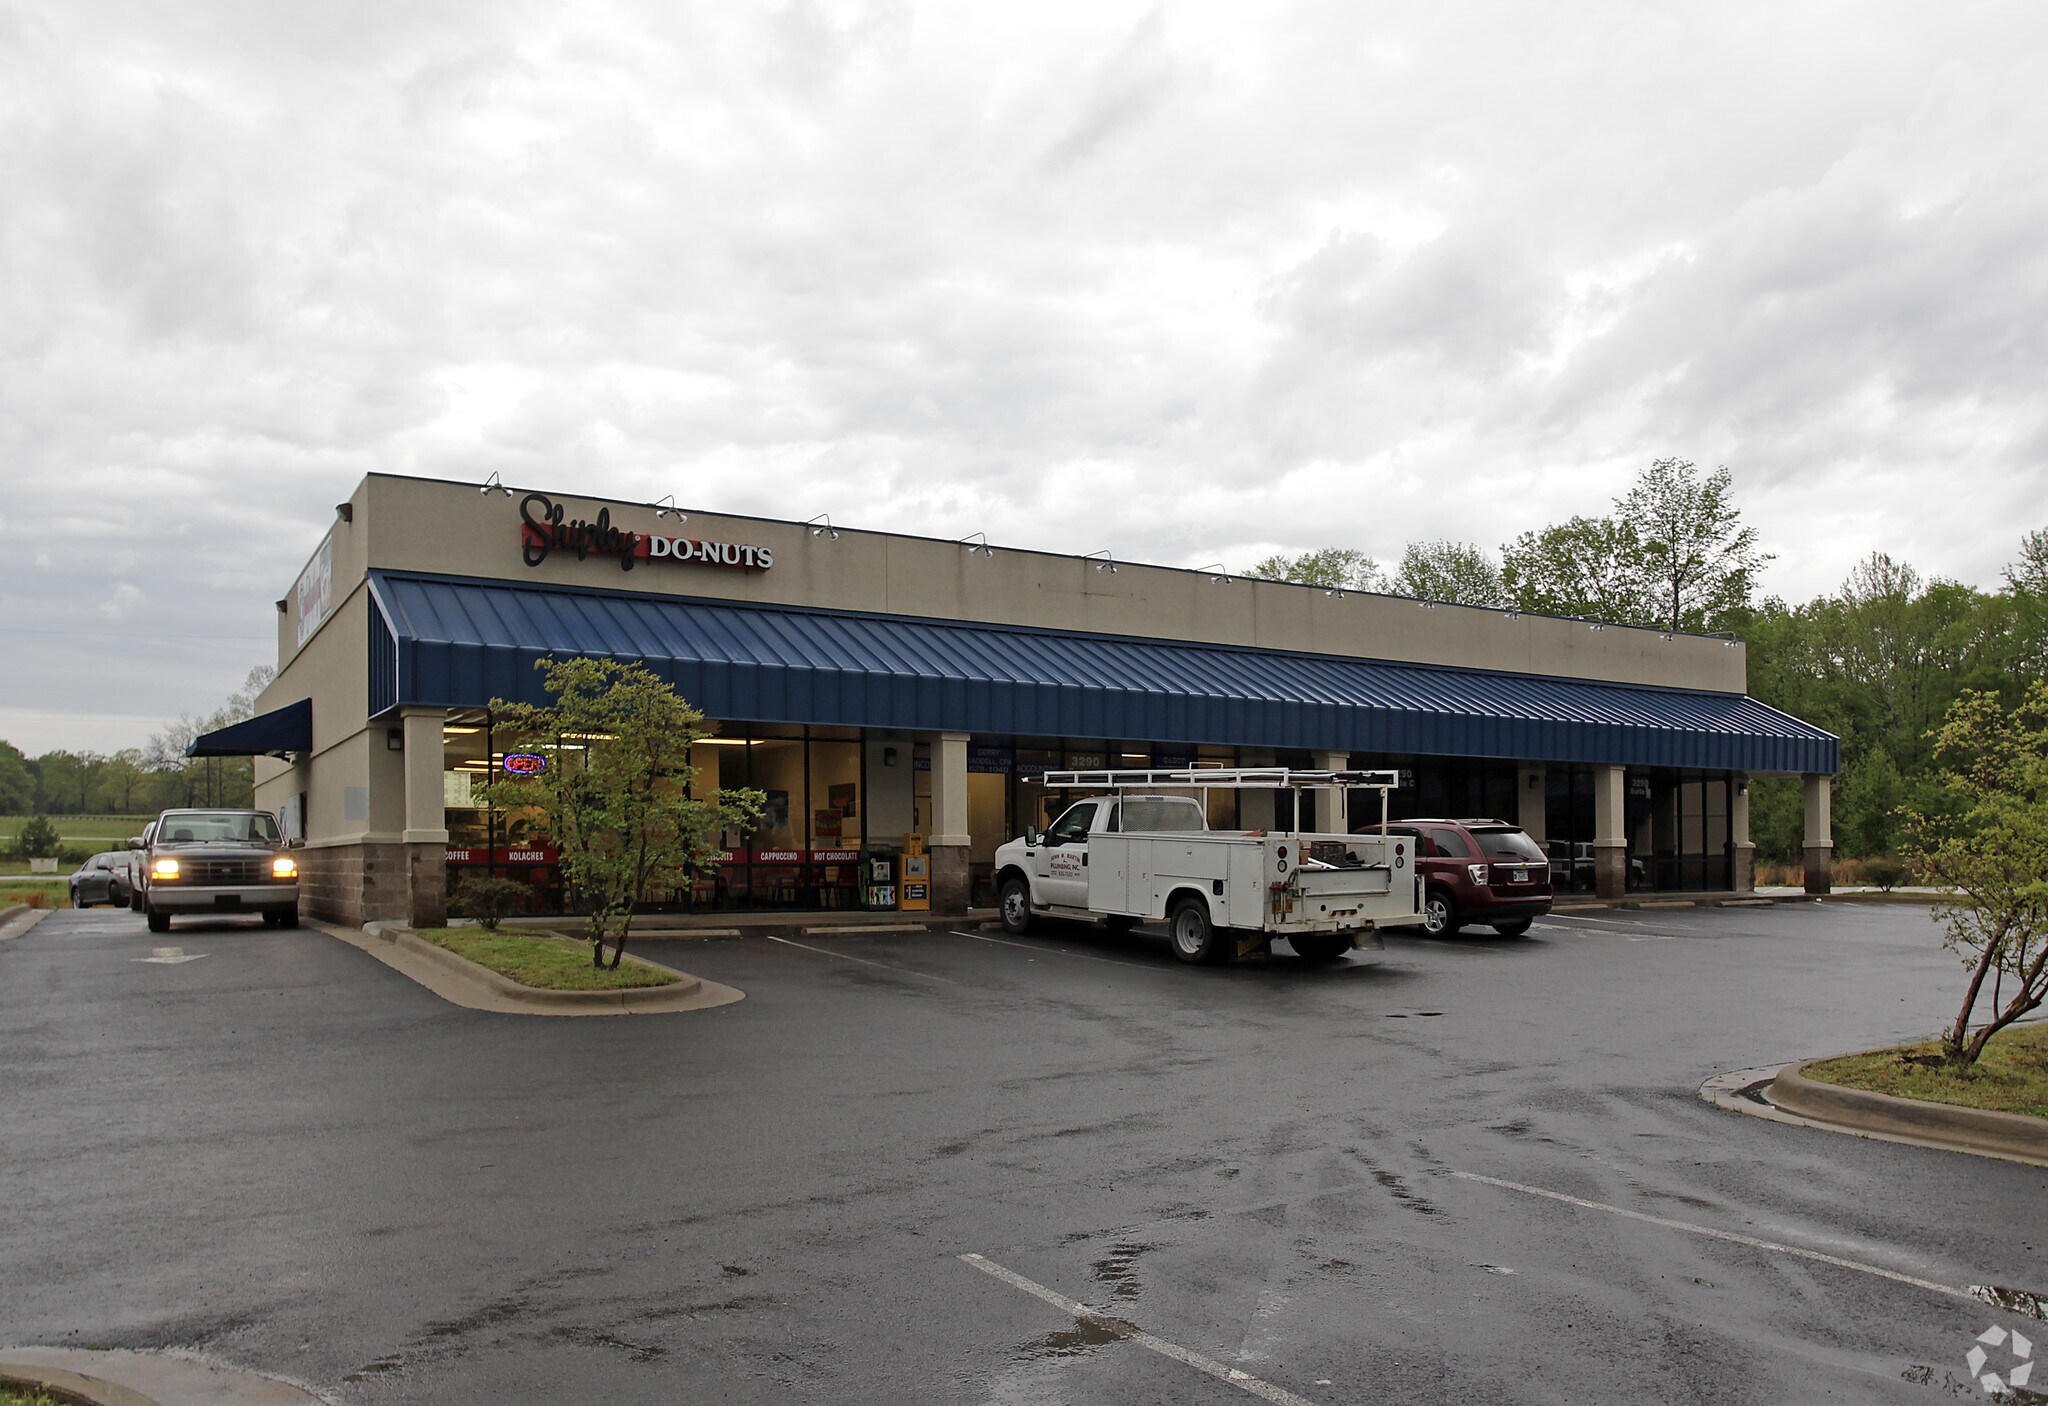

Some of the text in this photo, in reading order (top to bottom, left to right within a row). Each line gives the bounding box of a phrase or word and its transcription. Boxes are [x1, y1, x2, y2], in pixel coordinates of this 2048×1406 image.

[519, 493, 774, 572] Shipley DO-NUTS
[507, 757, 541, 771] OPEN
[999, 758, 1012, 766] CPA
[1071, 756, 1100, 767] 3290
[445, 851, 469, 861] COFFEE
[508, 851, 543, 861] KOLACHES
[760, 852, 798, 861] CAPPUCCINO
[814, 852, 858, 861] HOT CHOCOLATE
